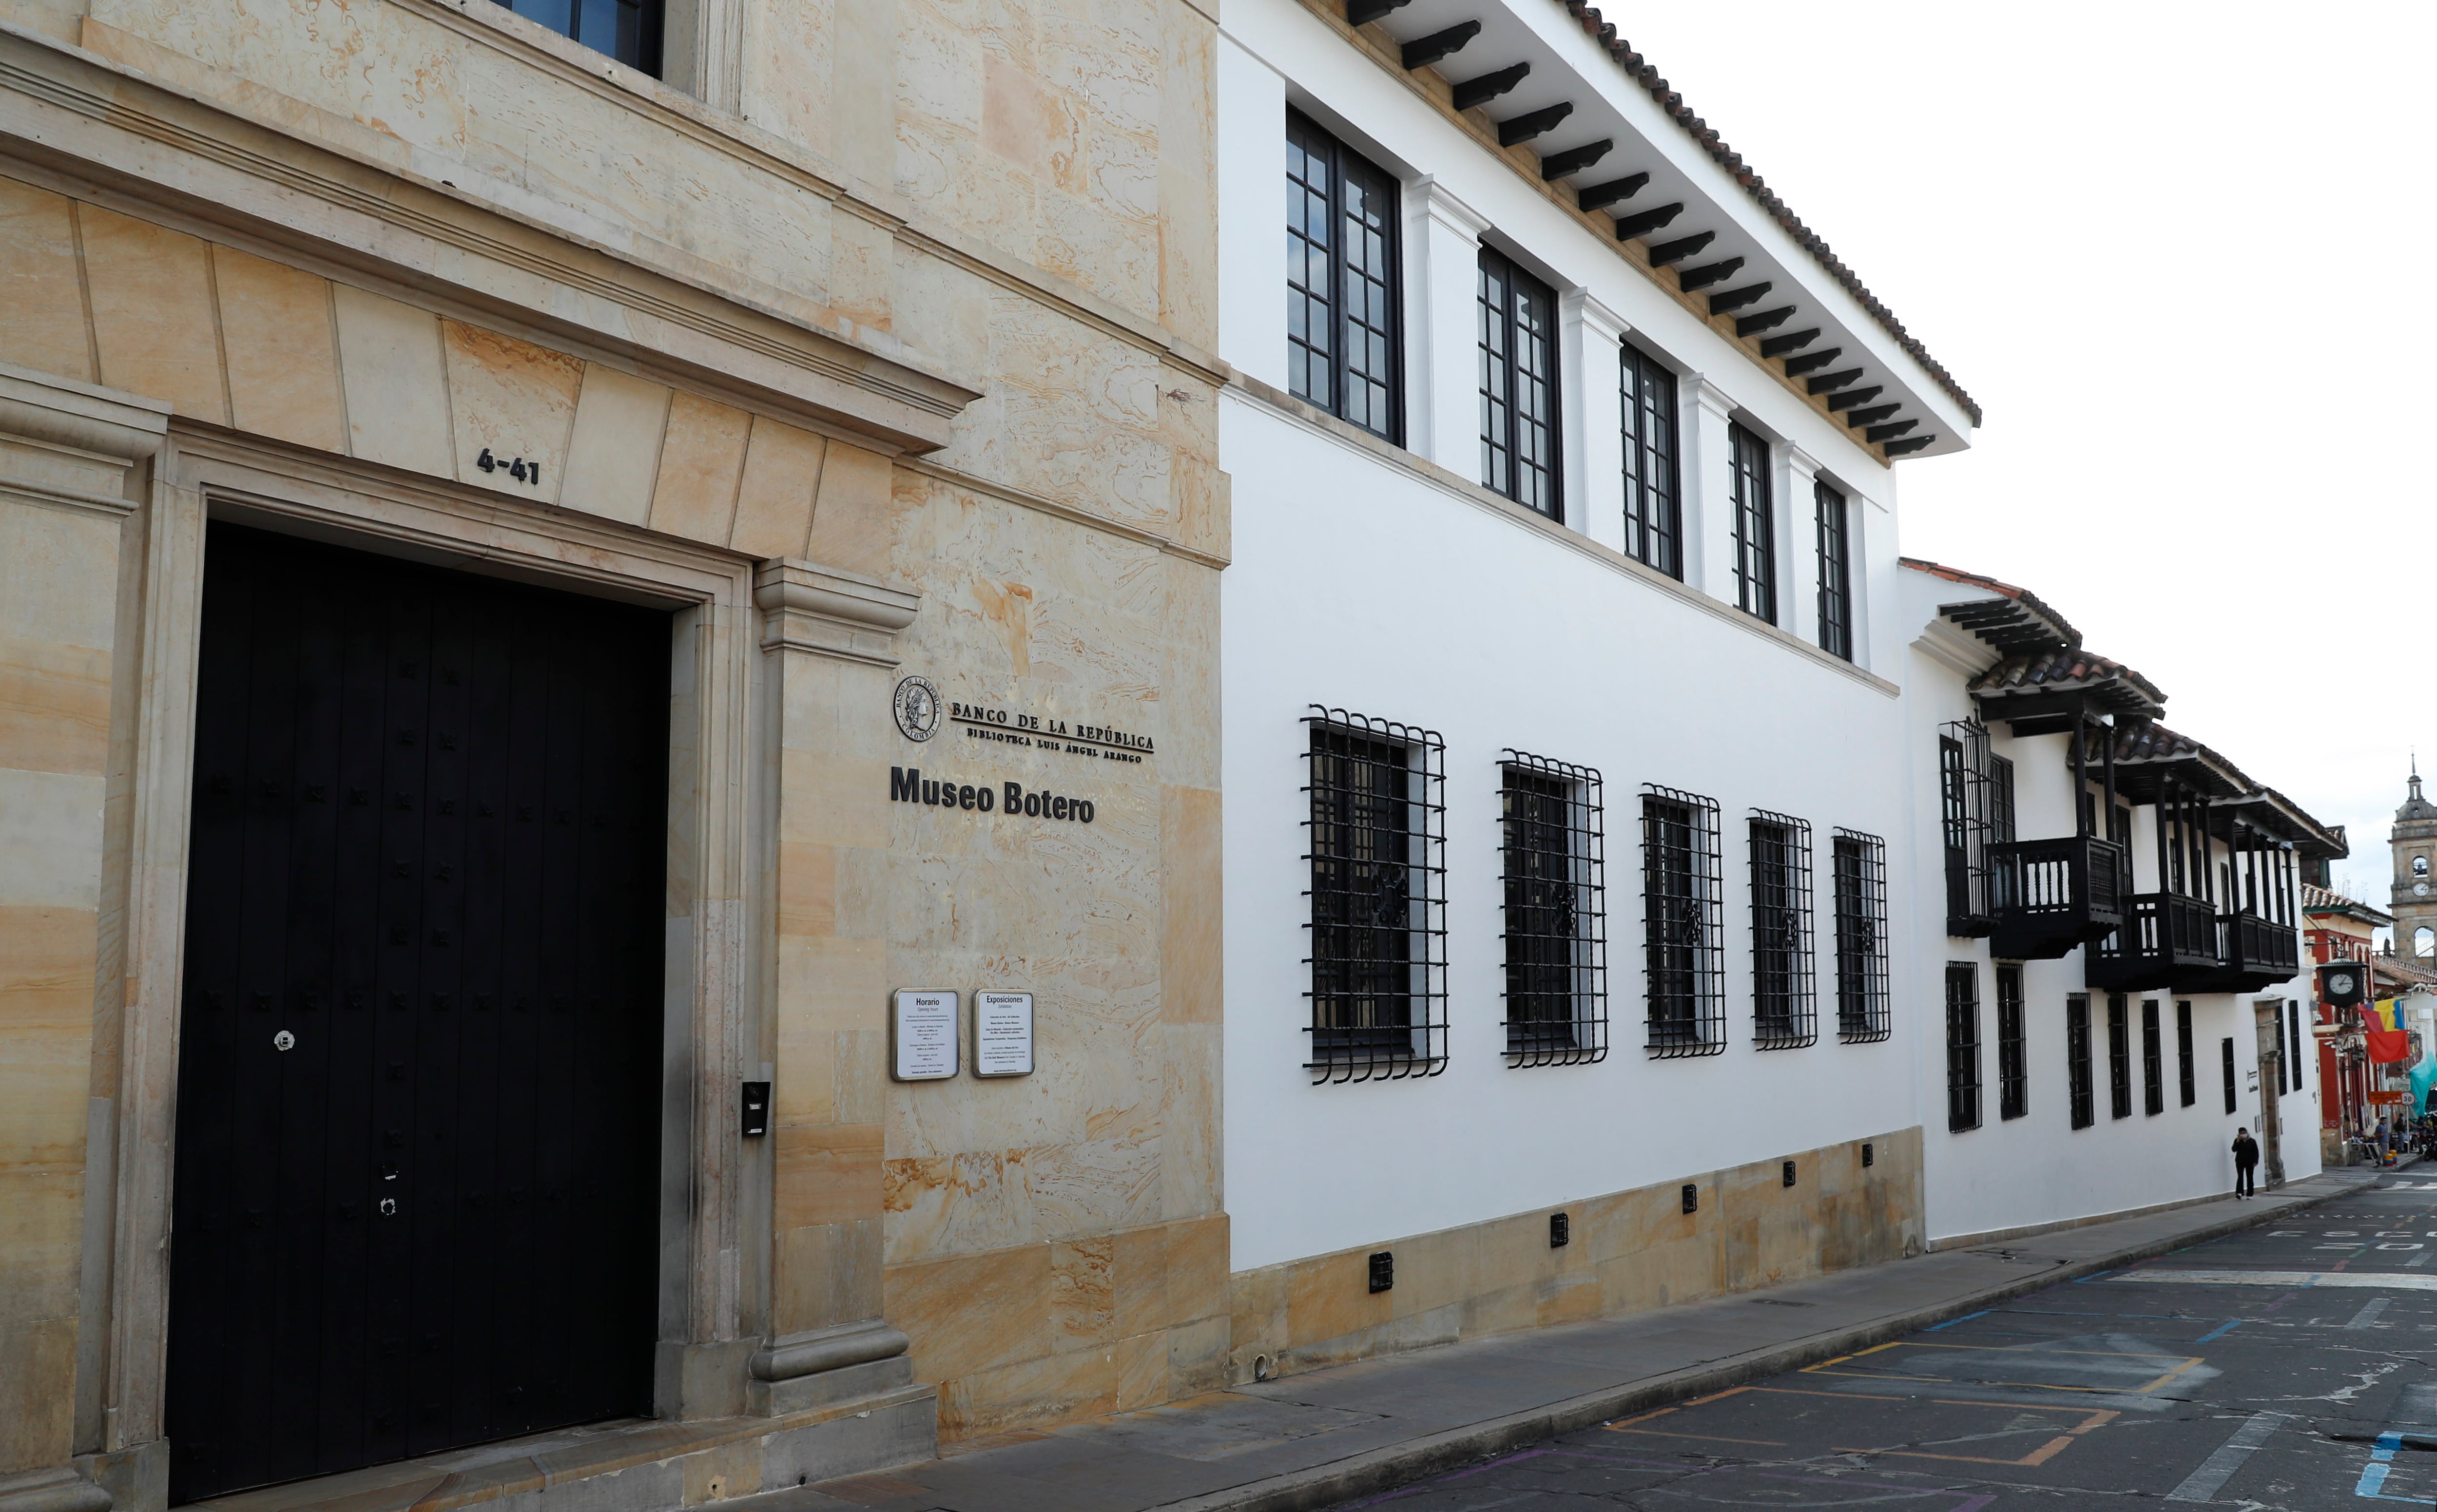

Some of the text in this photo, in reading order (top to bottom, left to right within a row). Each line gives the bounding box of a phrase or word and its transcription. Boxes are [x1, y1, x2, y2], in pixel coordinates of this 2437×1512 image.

[477, 448, 539, 484] 4-41
[896, 686, 905, 708] BANCO
[902, 724, 935, 740] COLOMBIA
[952, 702, 1154, 749] BANCO DE LA REPÚBLICA
[967, 727, 1141, 764] BIBLIOTECA LUIS ÁNGEL ARANGO
[891, 766, 1095, 823] Museo Botero
[916, 997, 940, 1006] Horario
[986, 995, 1023, 1005] Exposiciones
